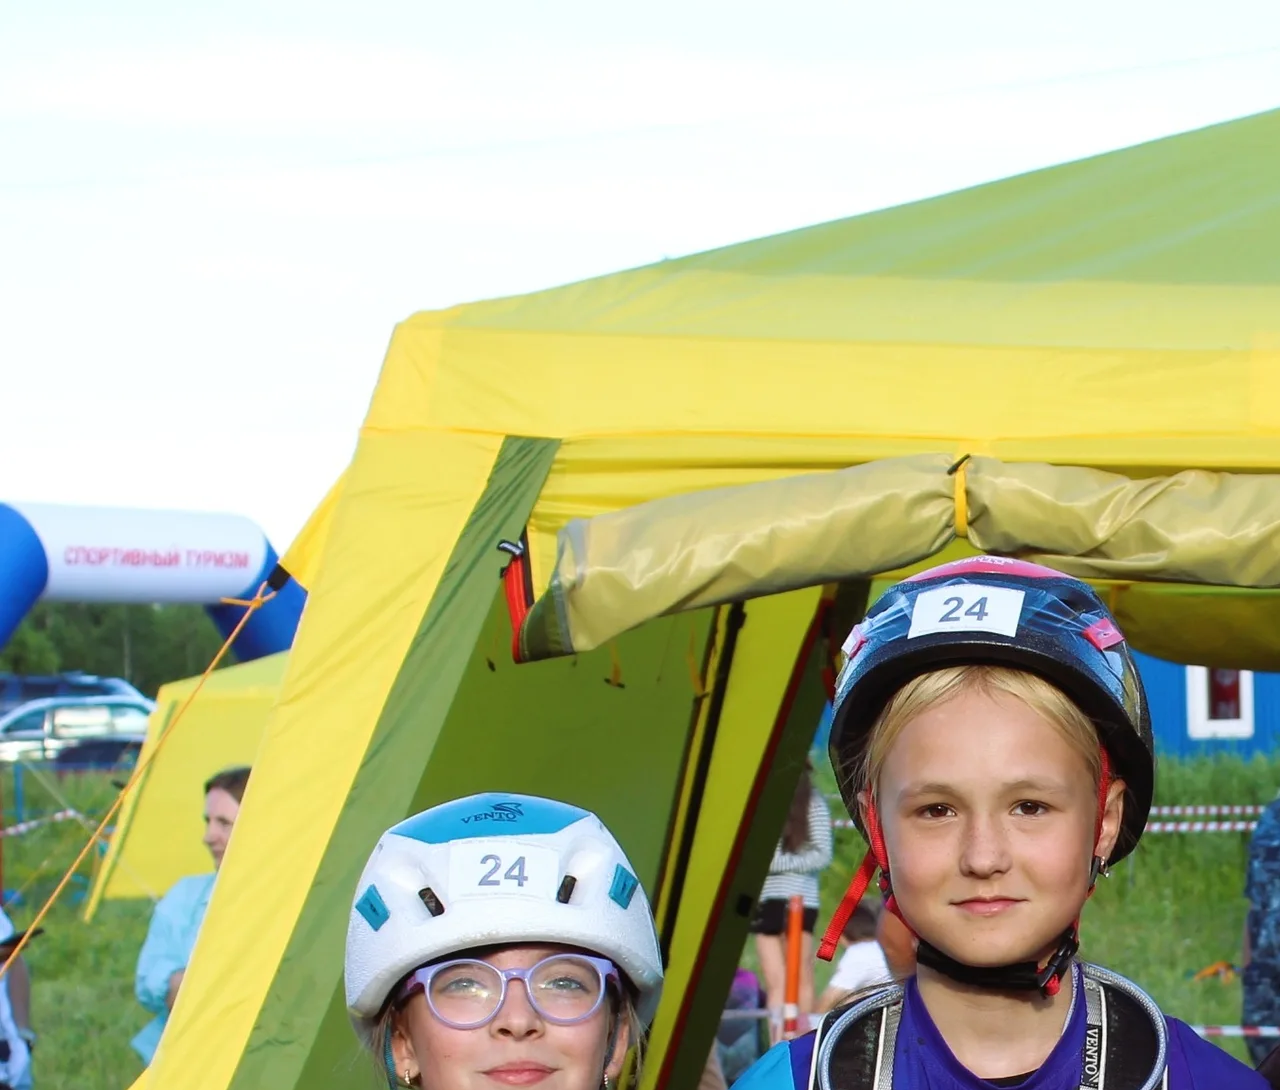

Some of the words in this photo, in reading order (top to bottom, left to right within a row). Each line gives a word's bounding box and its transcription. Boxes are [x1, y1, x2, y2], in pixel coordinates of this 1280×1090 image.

[938, 596, 989, 623] 24
[461, 811, 517, 824] VENTO
[478, 854, 529, 887] 24
[1085, 1027, 1099, 1076] VENTO
